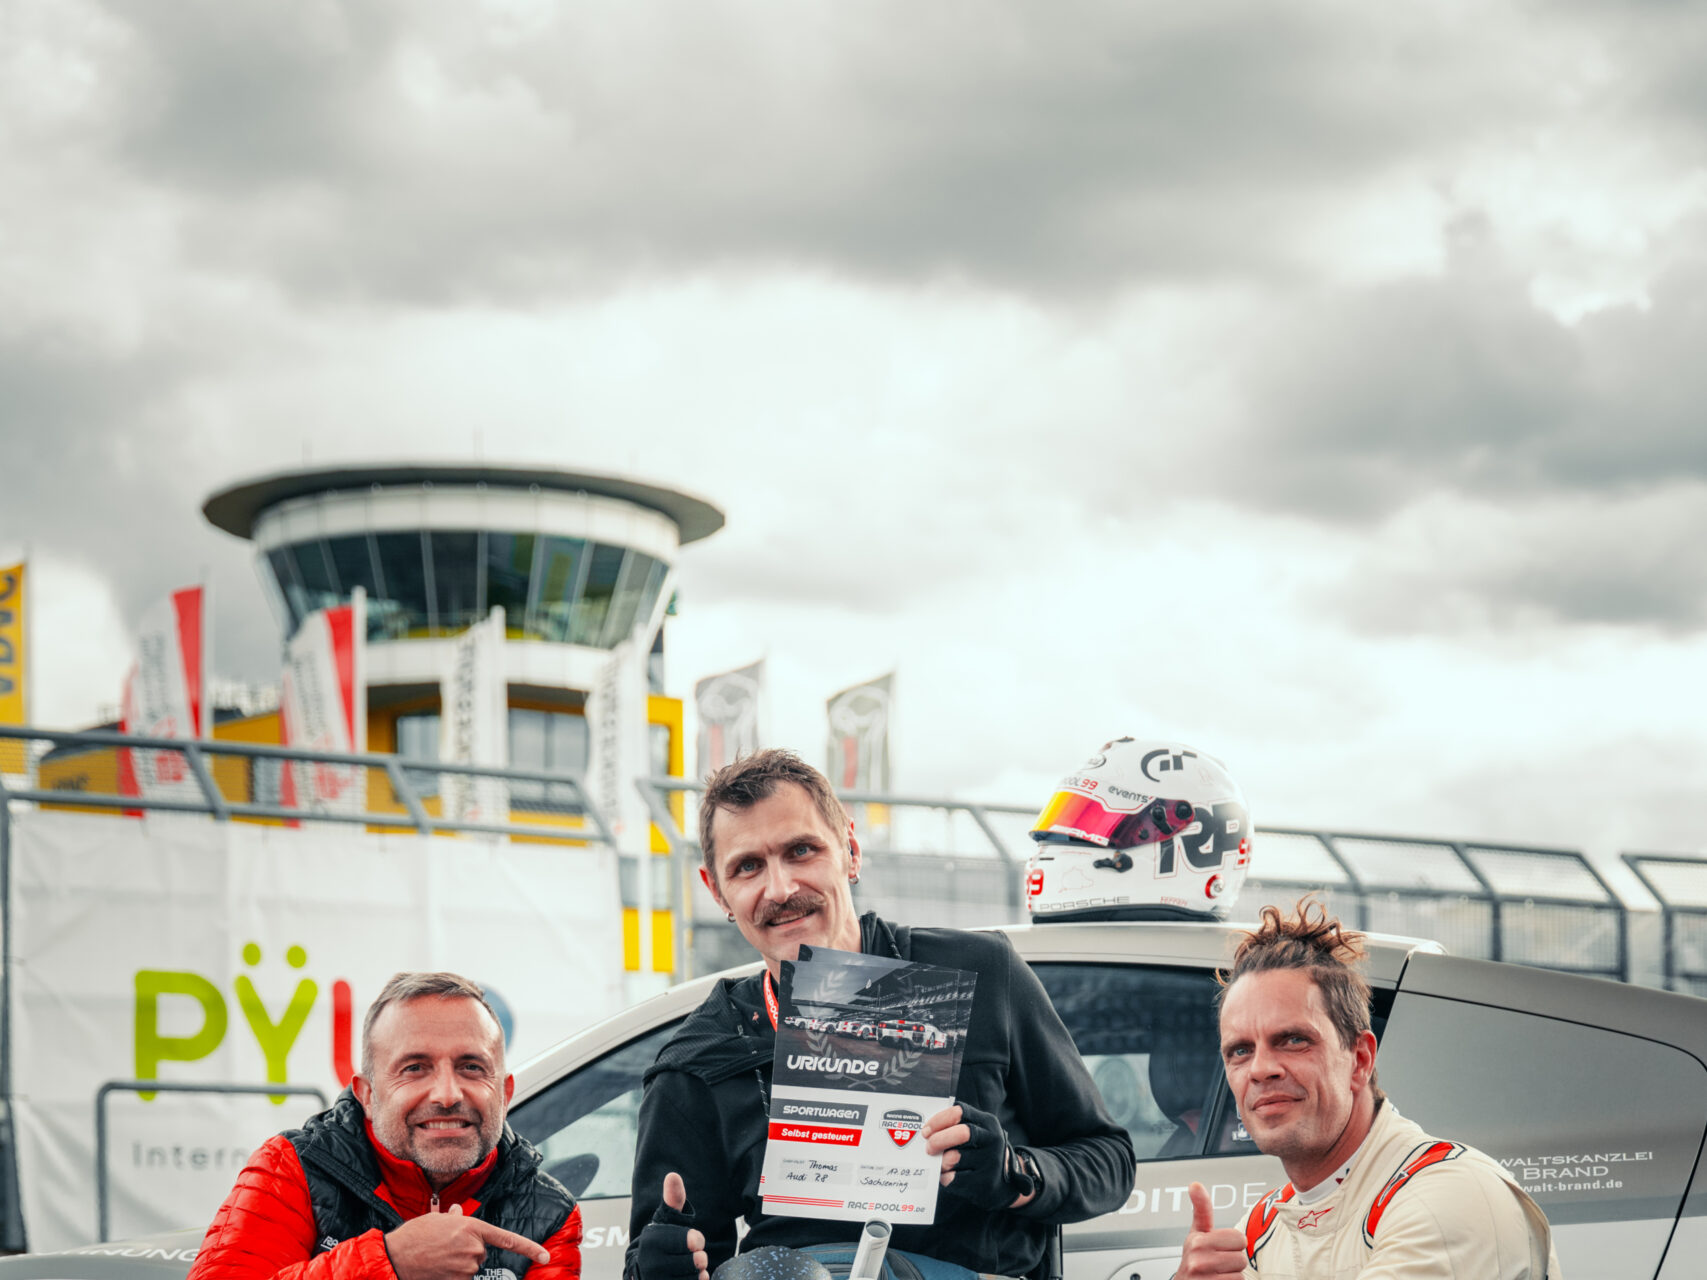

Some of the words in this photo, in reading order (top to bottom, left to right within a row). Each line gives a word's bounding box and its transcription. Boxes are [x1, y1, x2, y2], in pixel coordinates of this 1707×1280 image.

[1039, 896, 1130, 911] PORSCHE
[781, 1128, 810, 1139] Selbst
[811, 1131, 855, 1143] gesteuert
[893, 1130, 911, 1141] 99
[132, 1142, 247, 1171] Intern
[1499, 1151, 1653, 1168] WALTSKANZLEI
[808, 1159, 838, 1172] Thomas
[786, 1171, 807, 1181] Audi
[1522, 1179, 1624, 1193] walt-brand.de
[484, 1268, 503, 1276] THE
